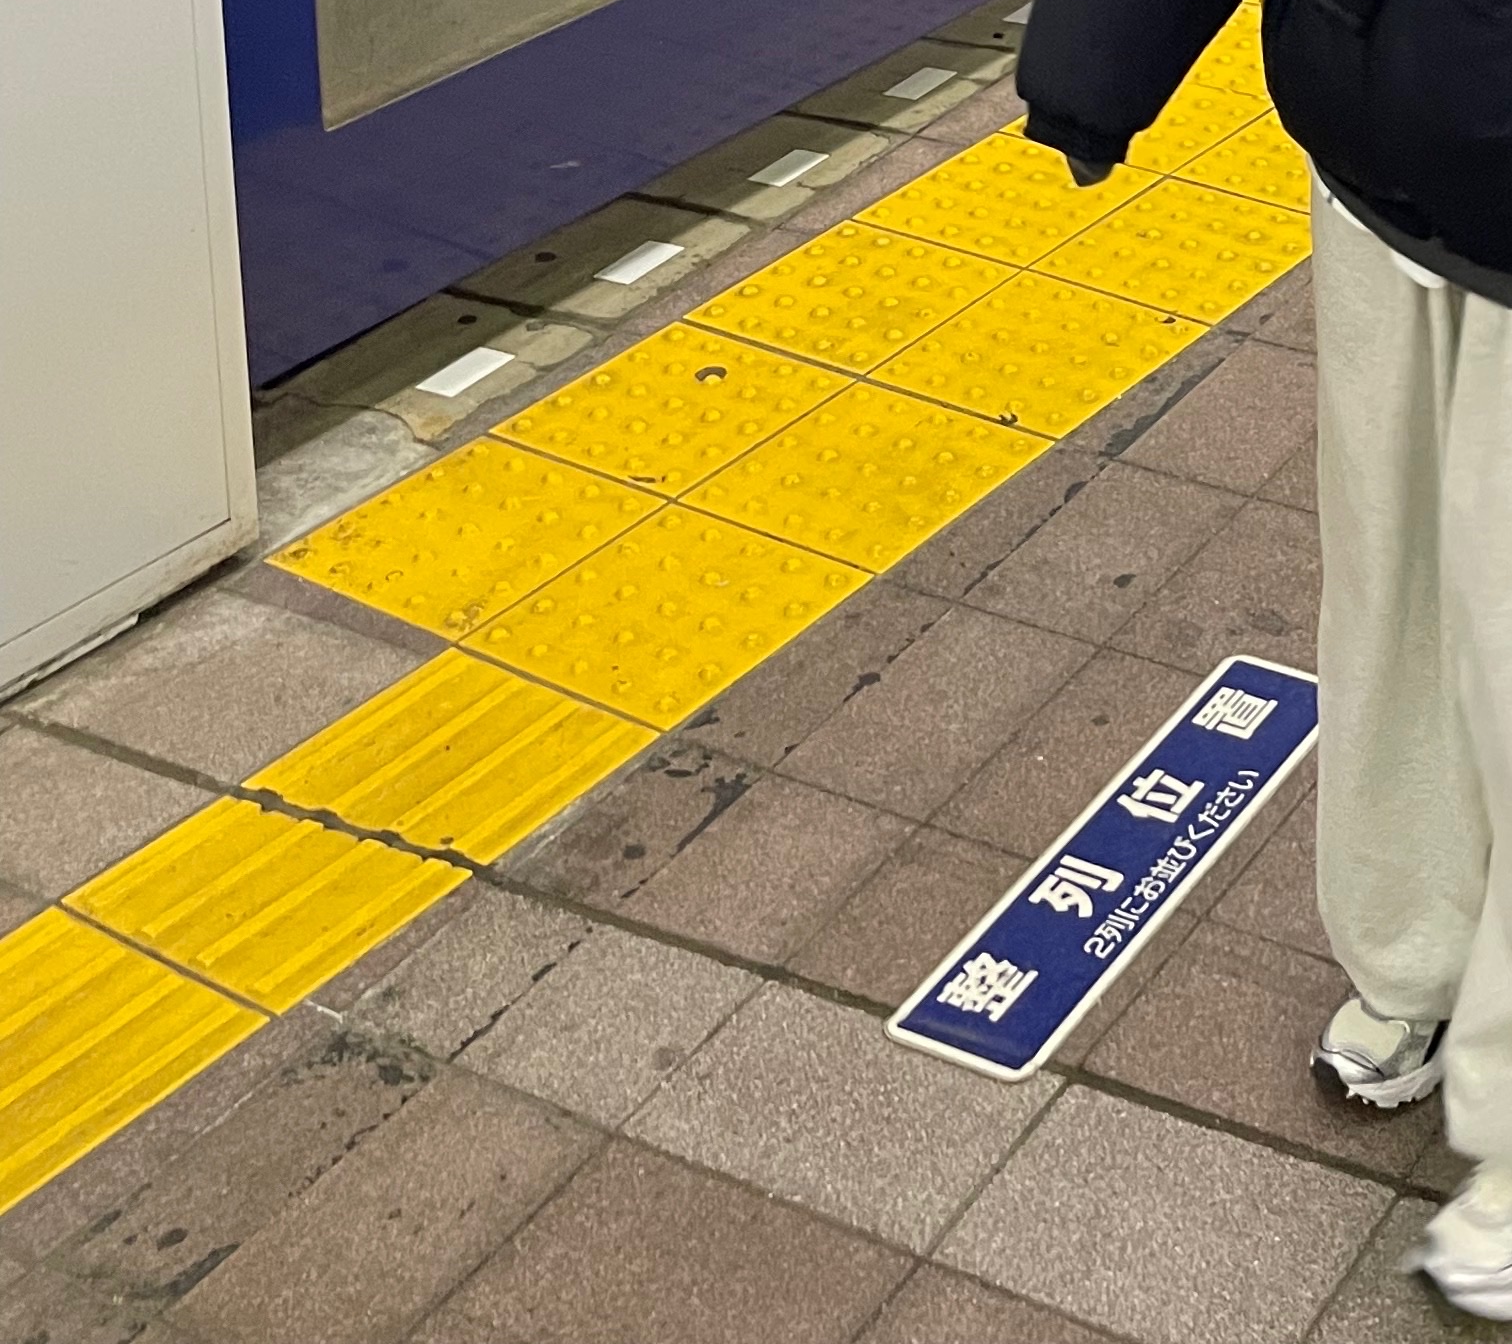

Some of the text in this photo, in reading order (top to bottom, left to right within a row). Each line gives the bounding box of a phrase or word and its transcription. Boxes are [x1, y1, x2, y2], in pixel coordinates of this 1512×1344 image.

[937, 686, 1278, 1022] 整列位置
[1084, 769, 1260, 959] 2列にお並びください
